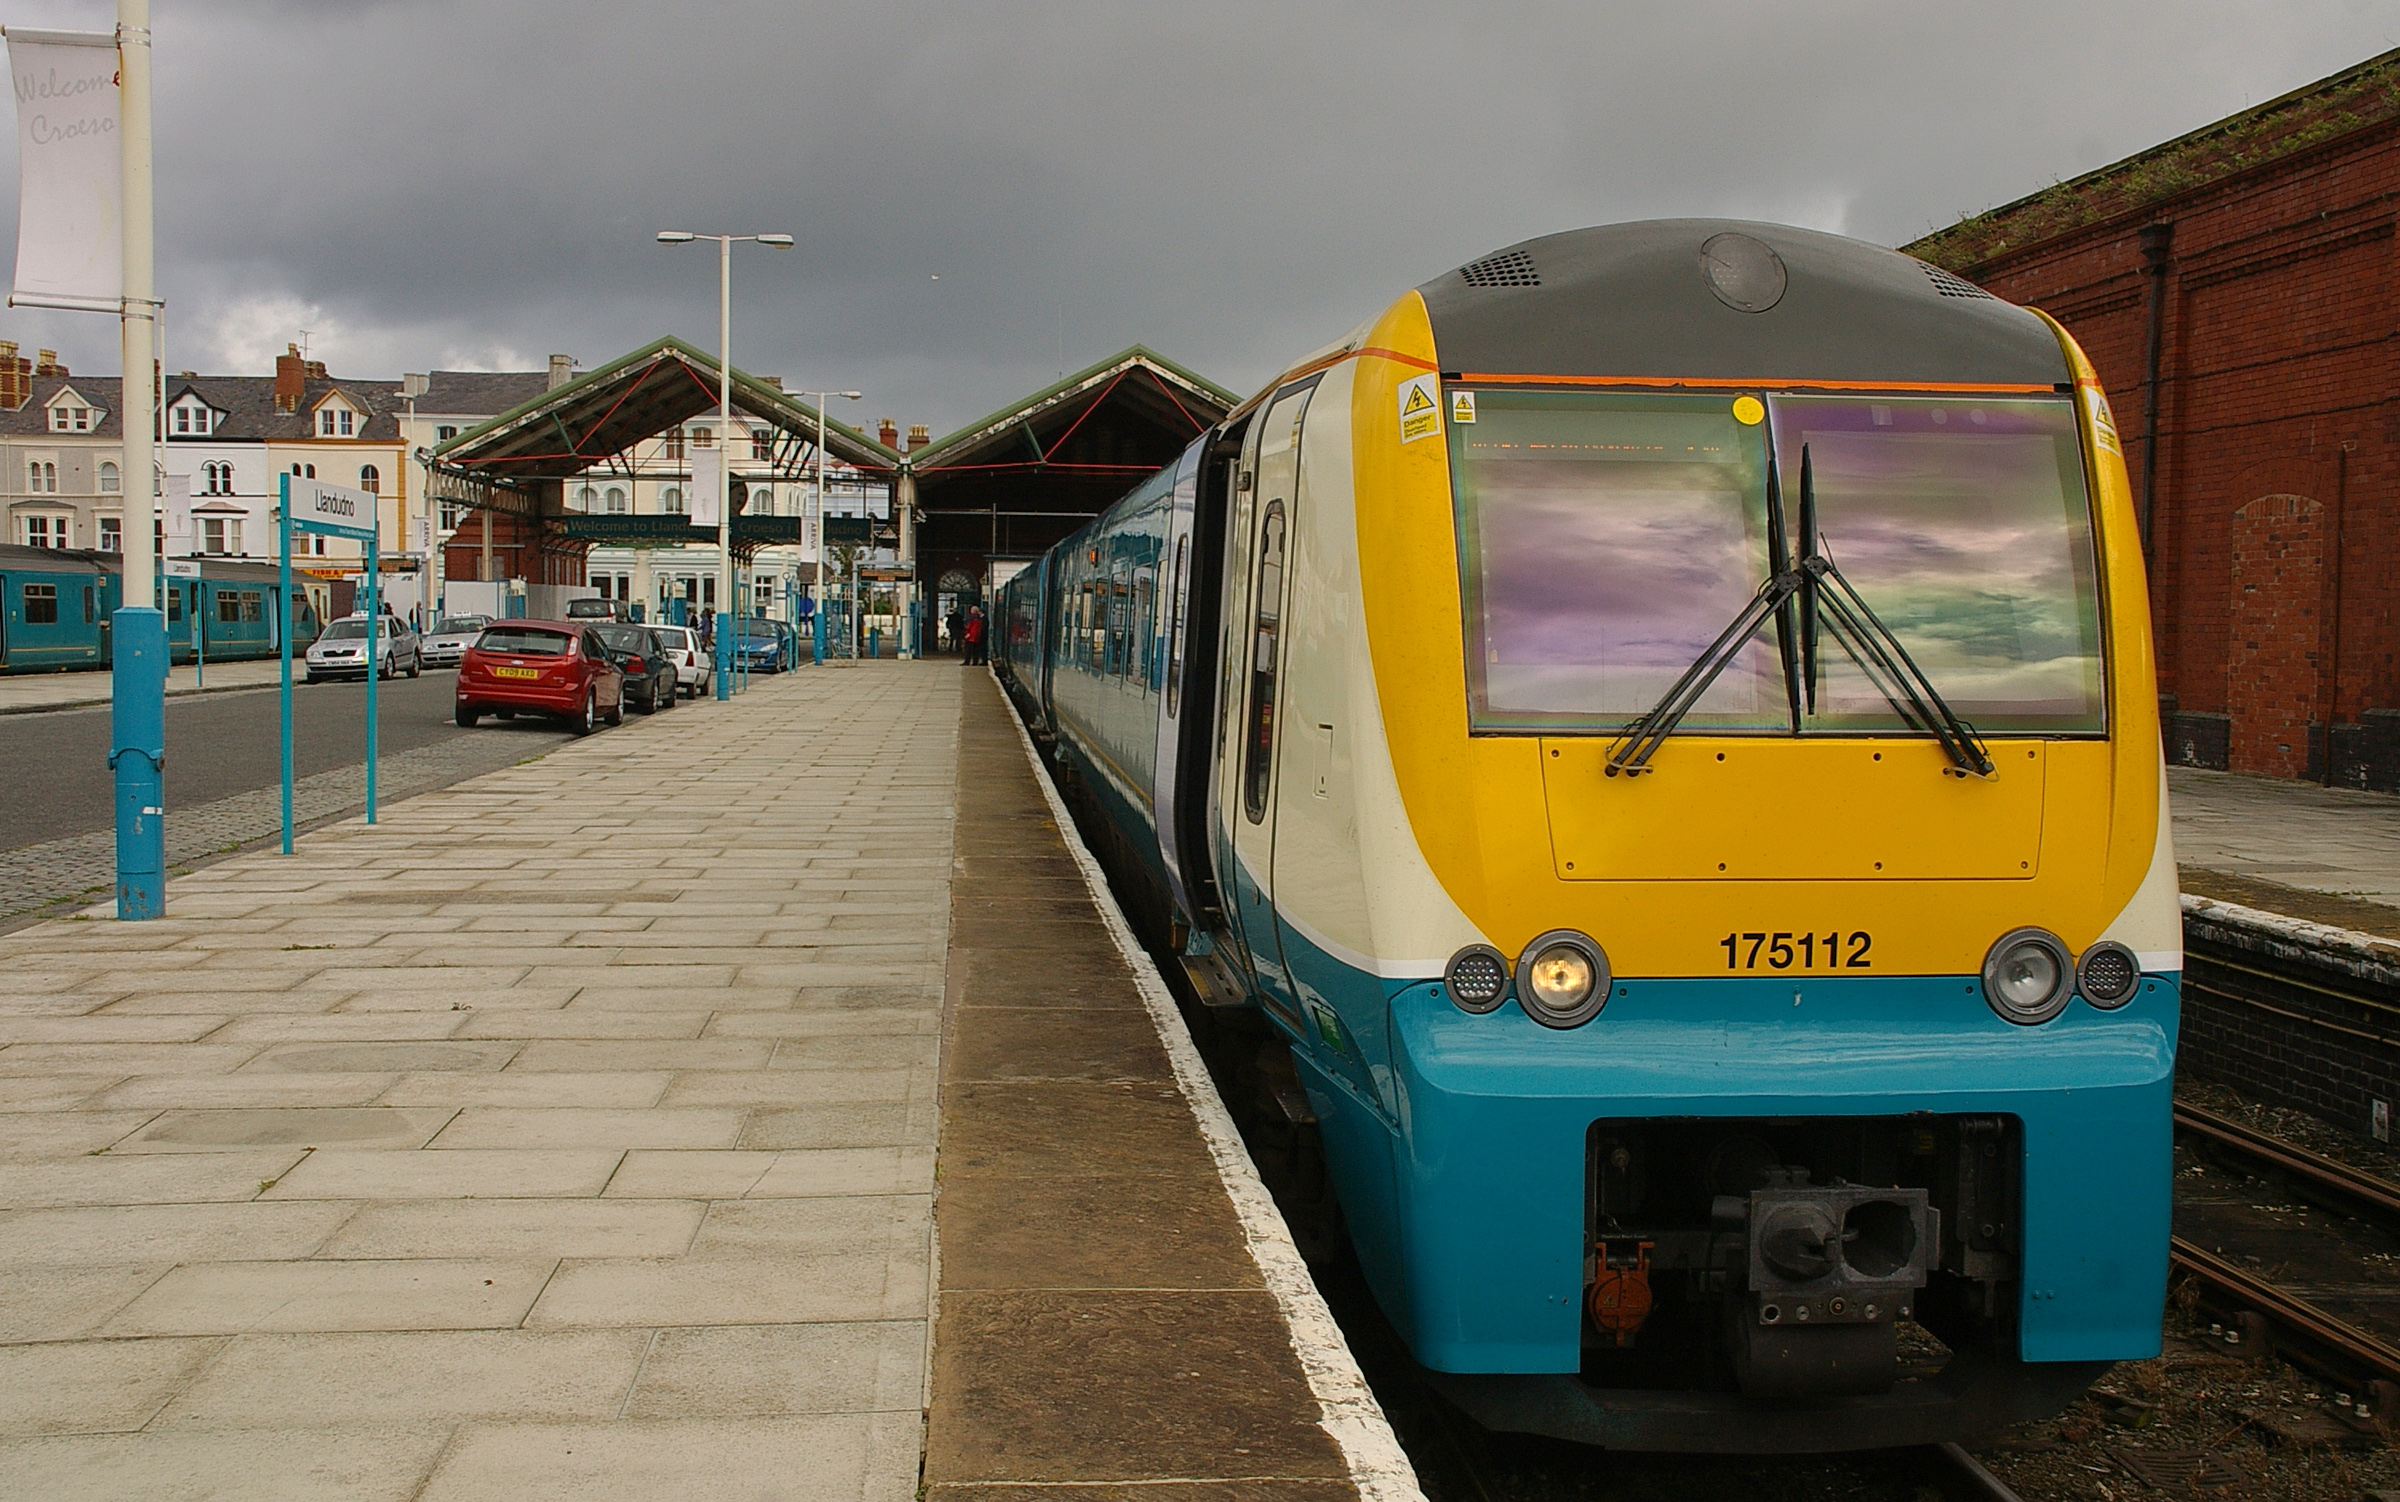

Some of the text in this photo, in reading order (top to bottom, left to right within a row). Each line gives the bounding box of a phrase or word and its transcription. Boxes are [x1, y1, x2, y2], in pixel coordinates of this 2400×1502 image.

[30, 113, 116, 145] Croeso
[1404, 415, 1431, 427] Danger
[315, 489, 355, 517] Llandudno
[570, 520, 629, 532] Welcome
[634, 521, 647, 532] to
[738, 522, 783, 533] Croeso
[1720, 931, 1872, 969] 175112
